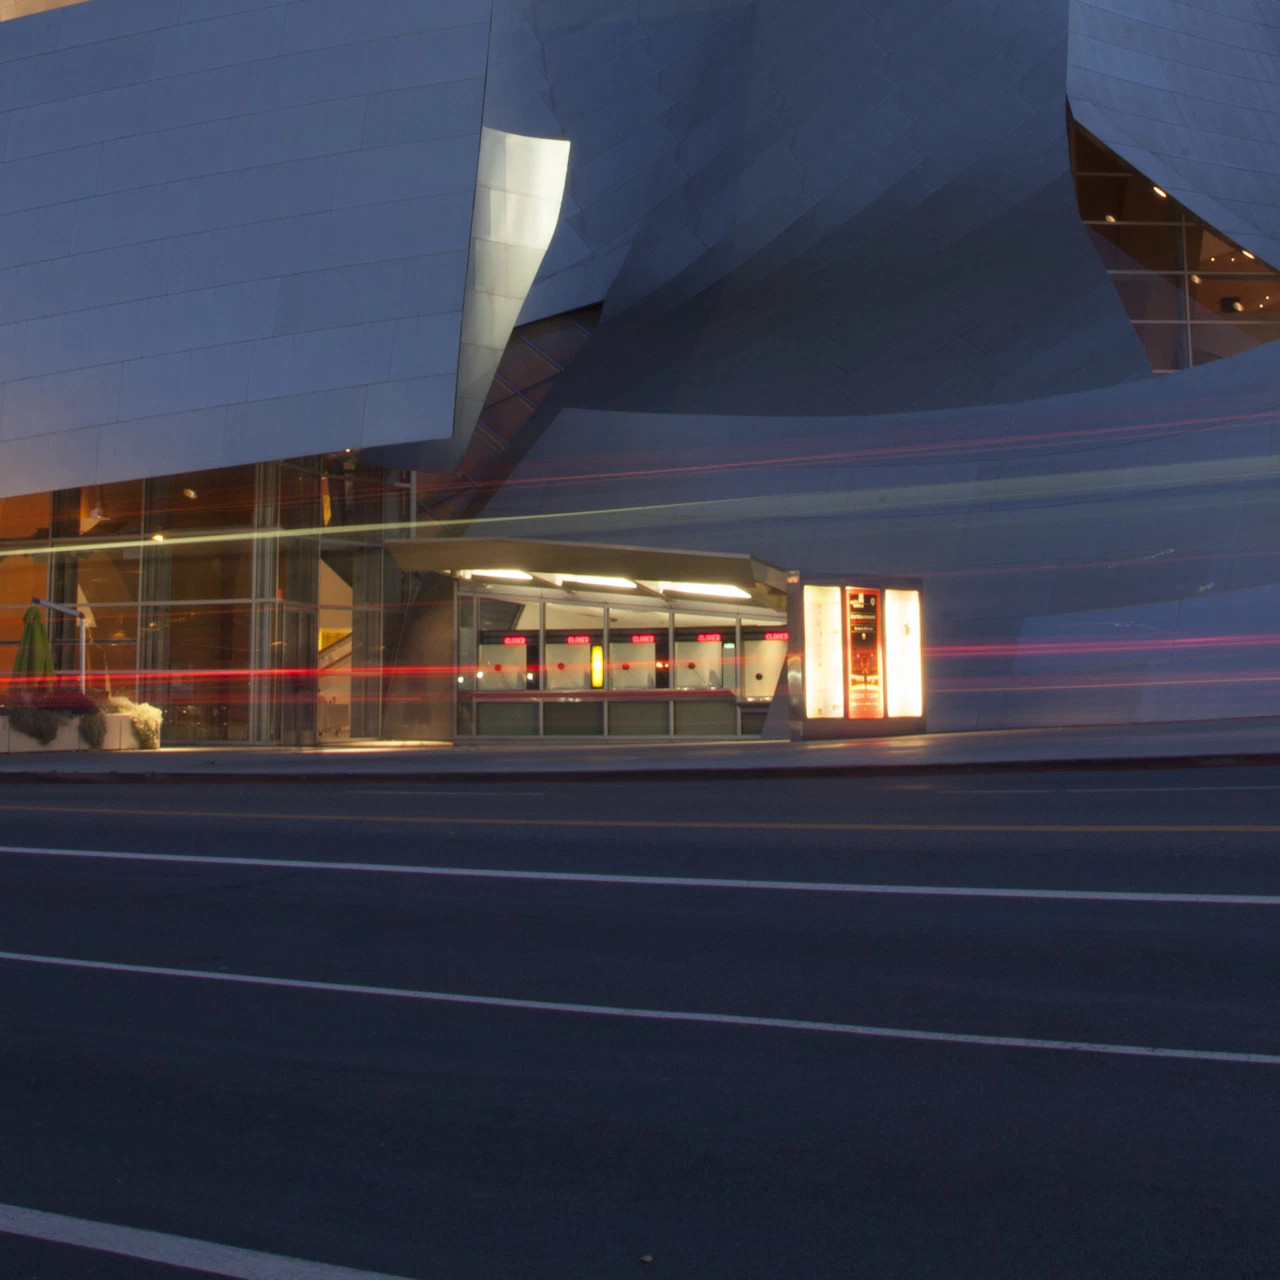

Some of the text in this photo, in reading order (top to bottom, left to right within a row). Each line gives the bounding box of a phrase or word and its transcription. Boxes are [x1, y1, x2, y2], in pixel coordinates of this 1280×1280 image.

[632, 634, 655, 644] CLOSED
[698, 632, 721, 642] CLOSED
[765, 632, 790, 641] CLOSED
